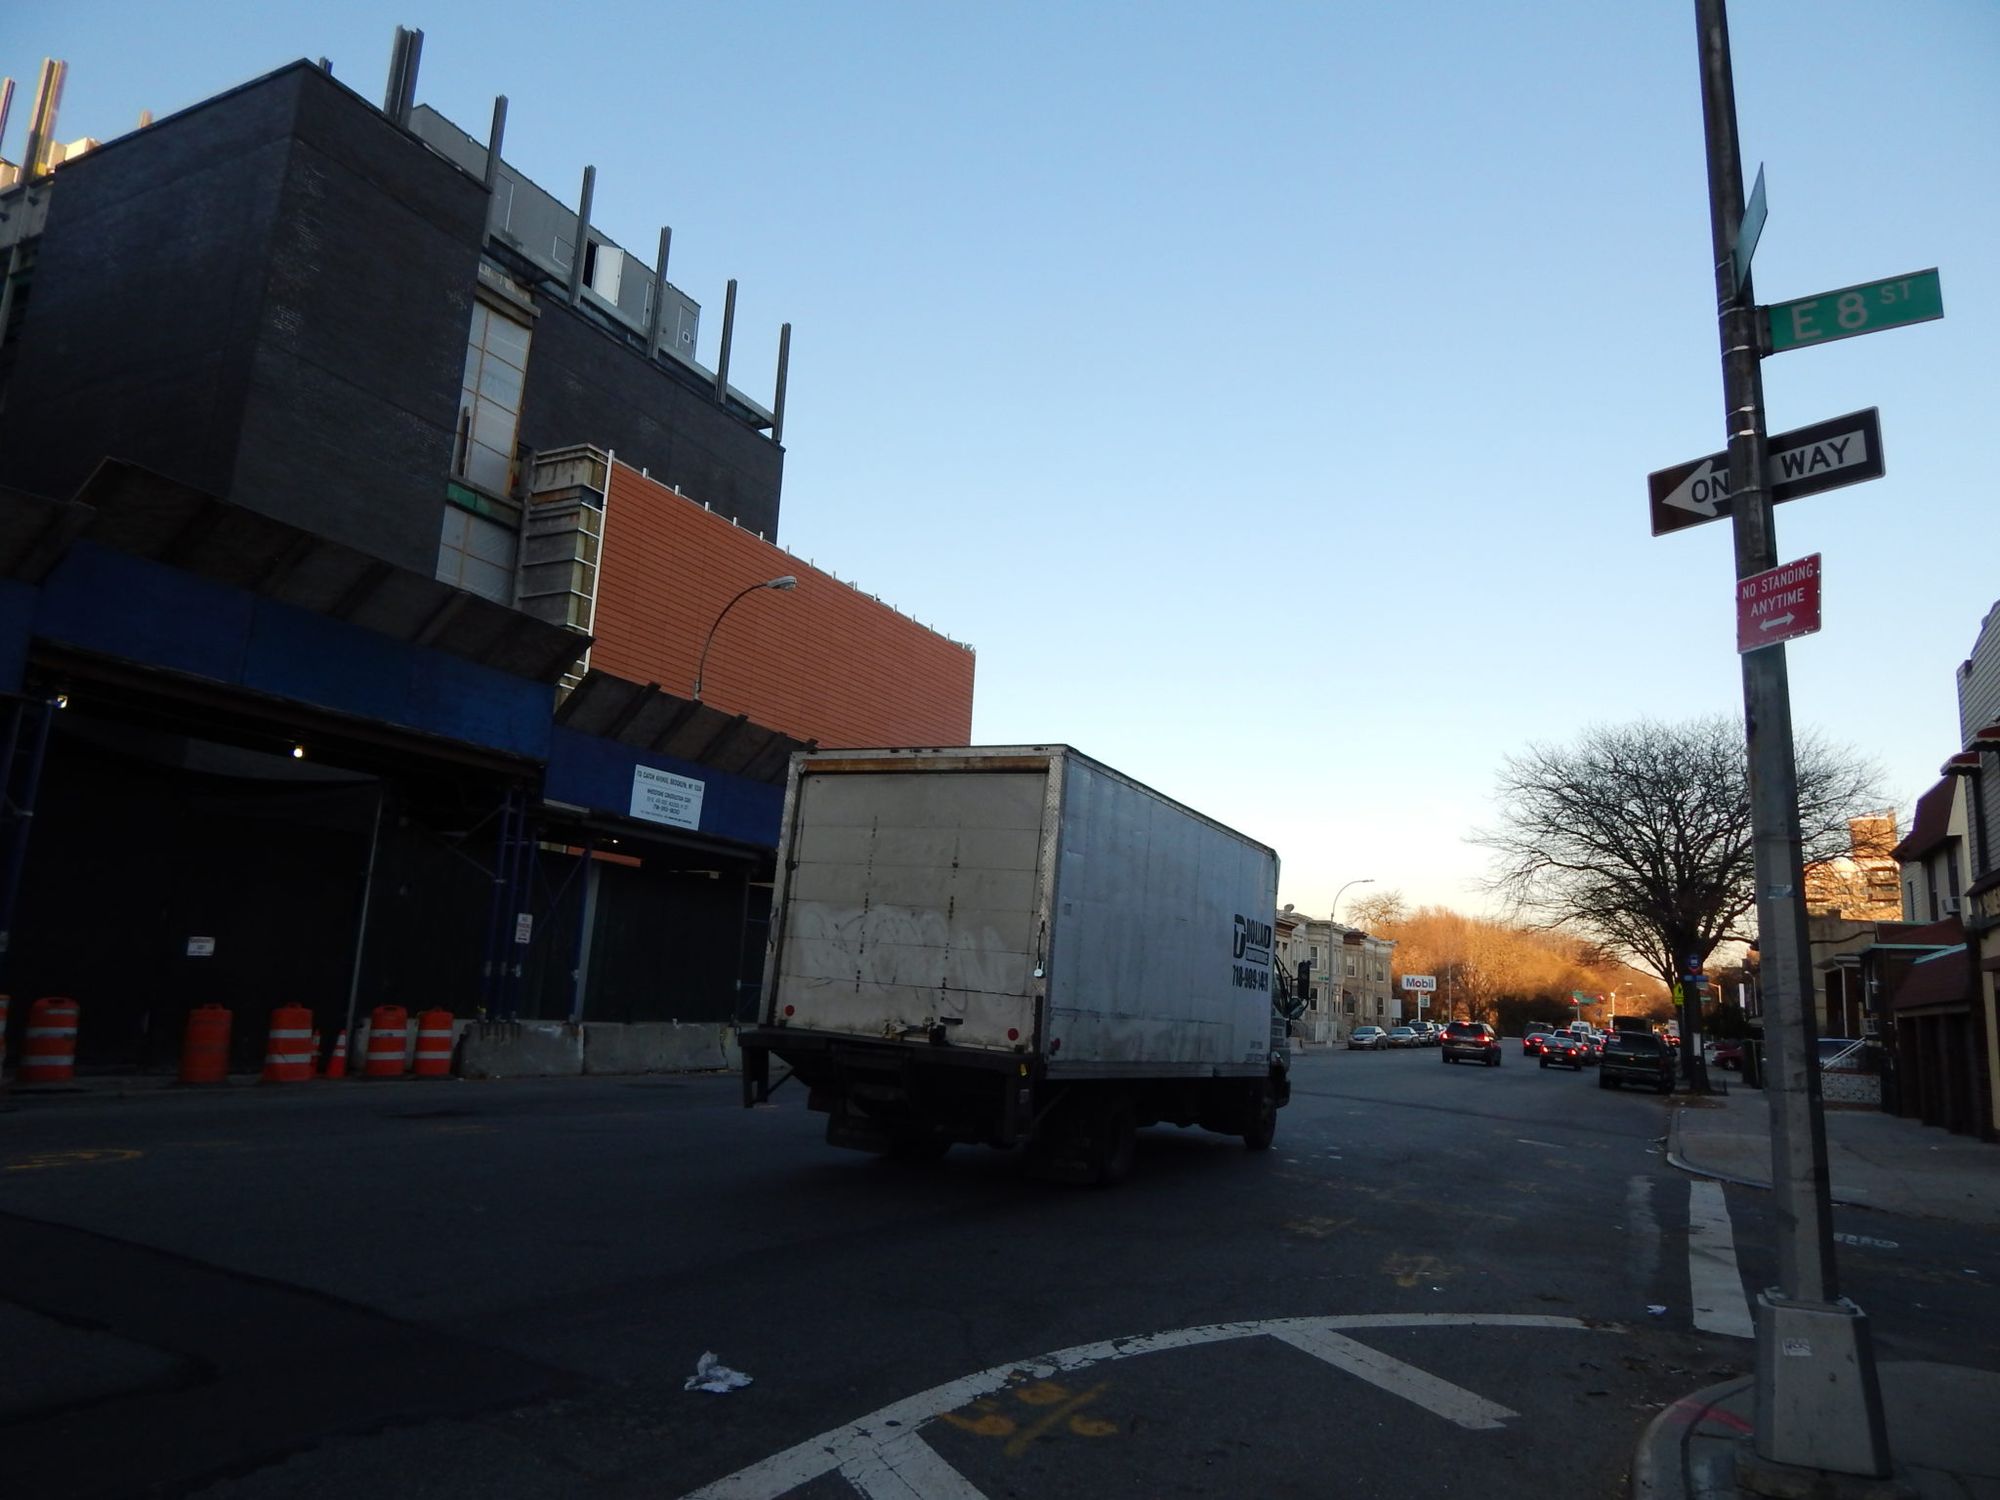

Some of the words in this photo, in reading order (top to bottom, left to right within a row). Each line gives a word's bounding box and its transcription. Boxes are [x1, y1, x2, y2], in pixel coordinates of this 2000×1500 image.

[1791, 301, 1822, 340] E
[1837, 291, 1868, 329] 8
[1880, 280, 1912, 304] ST
[1691, 472, 1730, 503] ON
[1780, 437, 1850, 478] WAY
[1742, 582, 1756, 600] NO
[1761, 563, 1814, 593] STANDING
[1751, 588, 1805, 617] ANYTIME
[1406, 978, 1434, 988] Mobil
